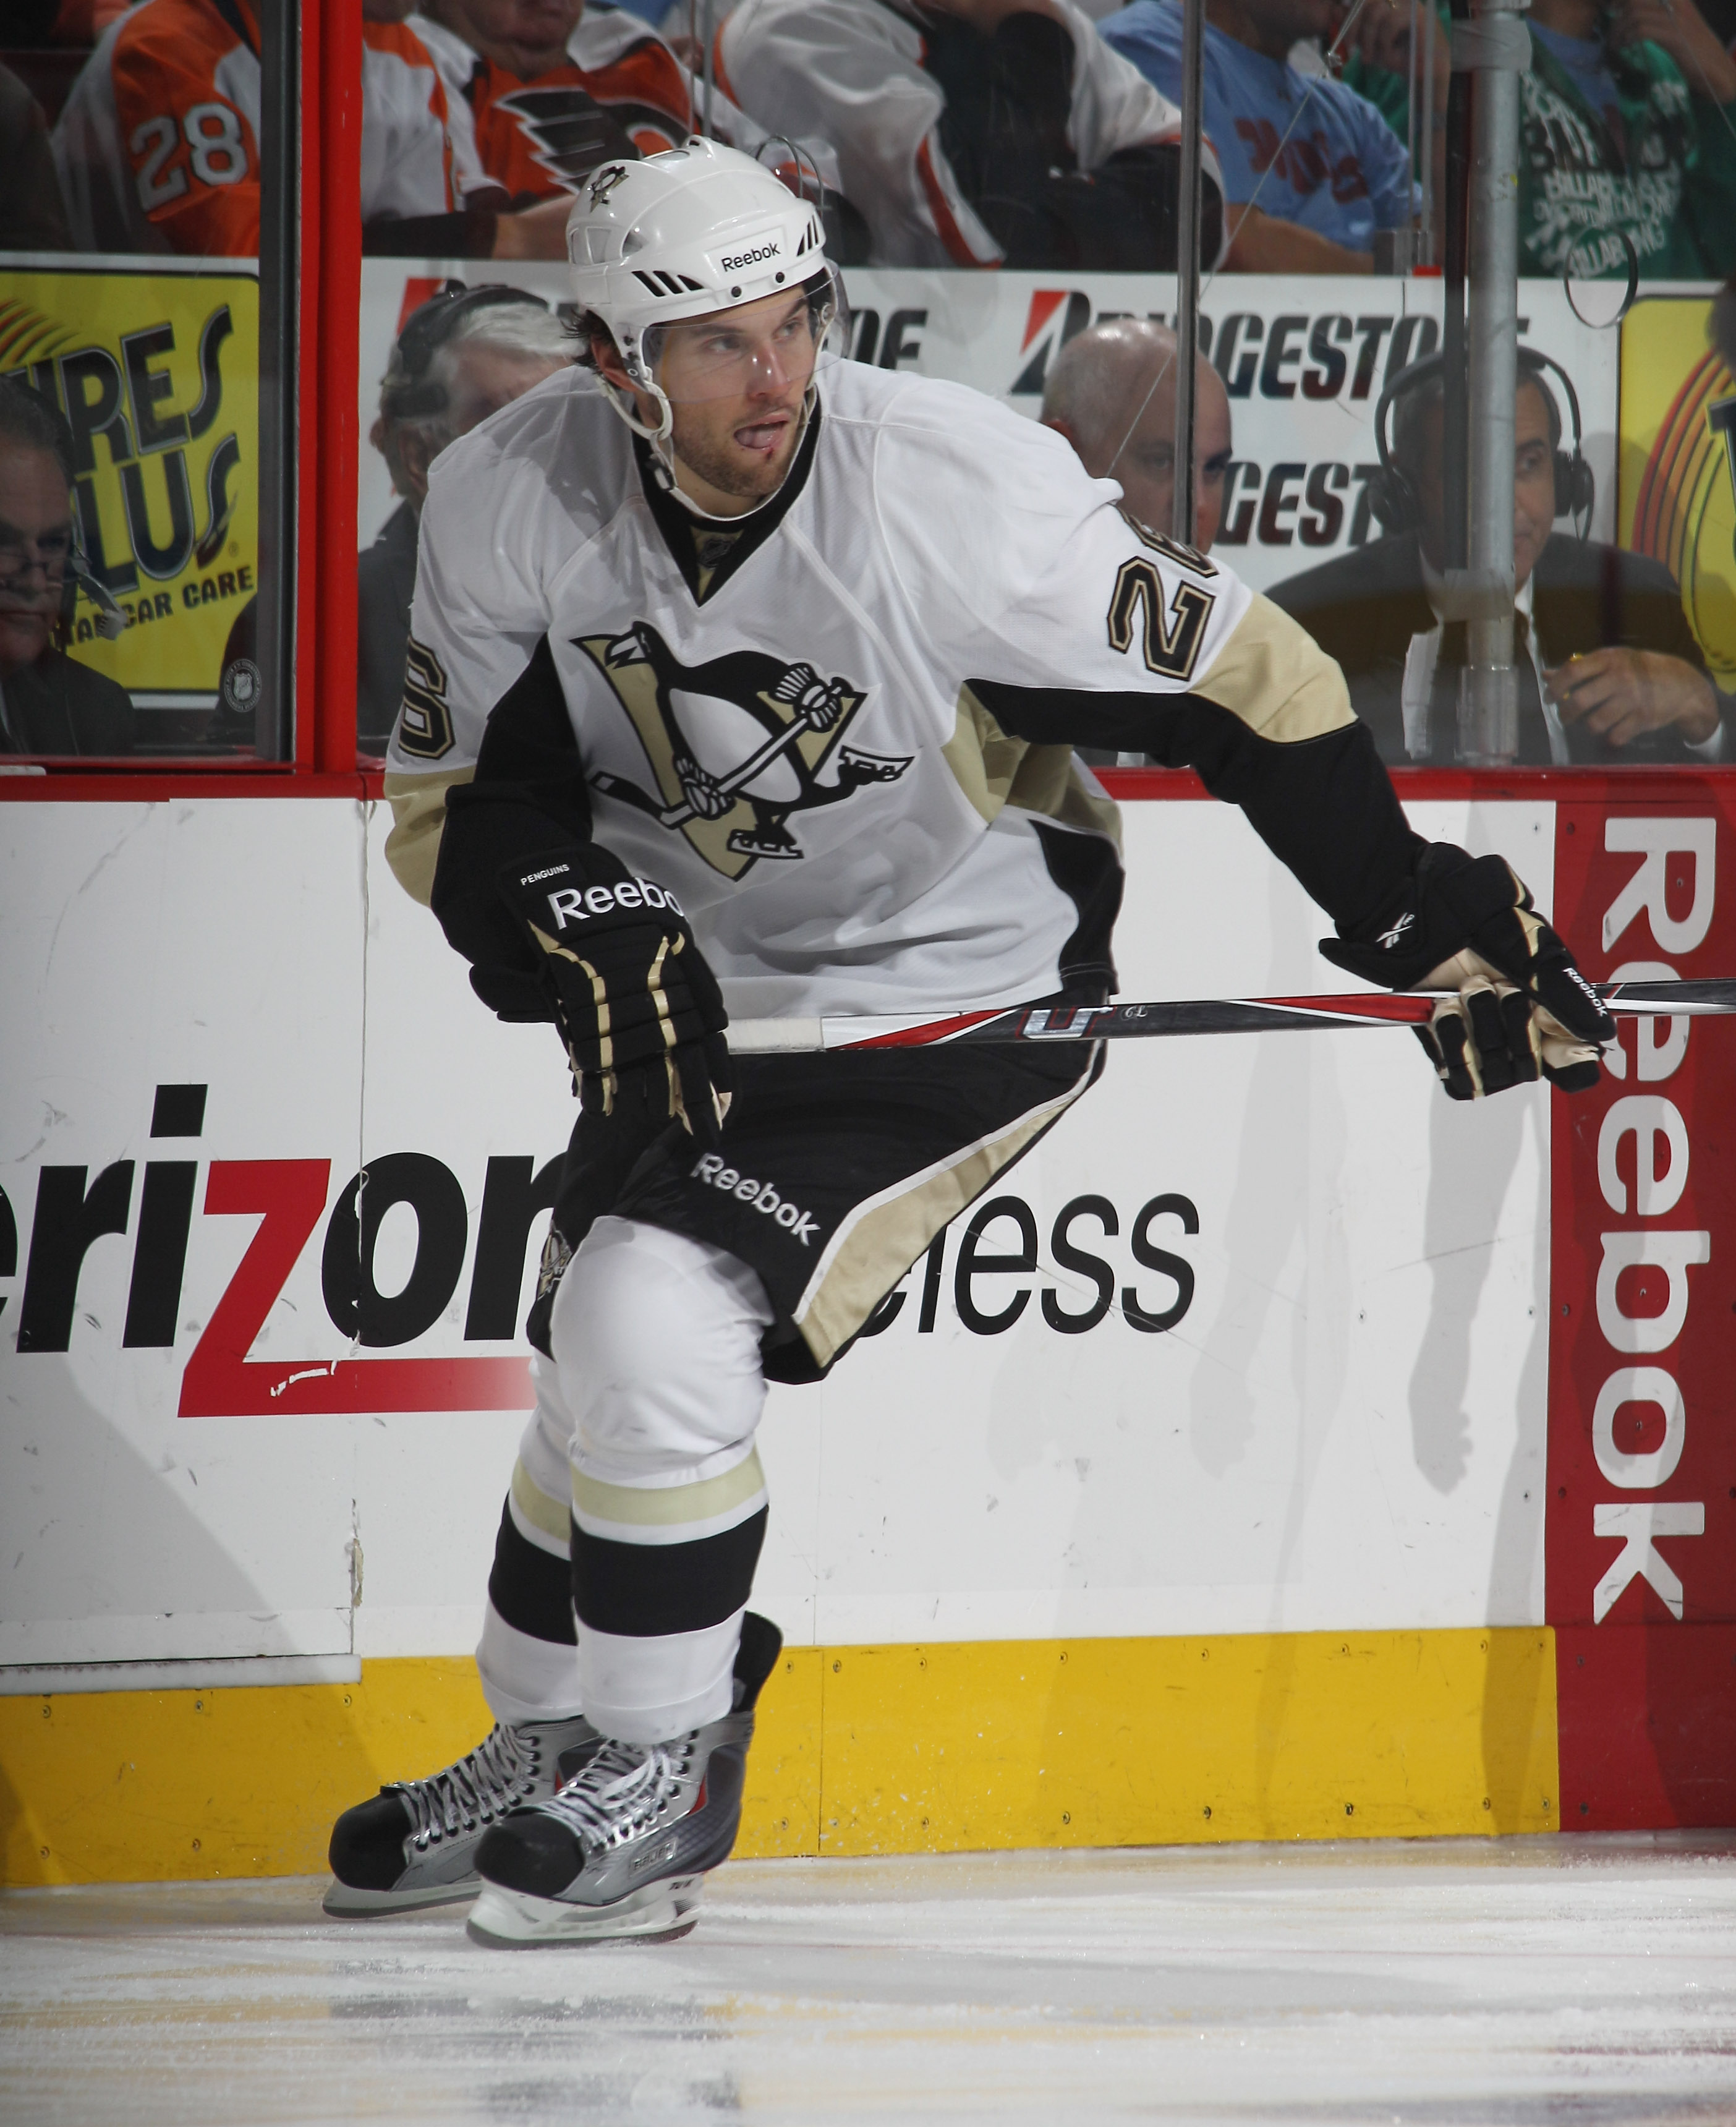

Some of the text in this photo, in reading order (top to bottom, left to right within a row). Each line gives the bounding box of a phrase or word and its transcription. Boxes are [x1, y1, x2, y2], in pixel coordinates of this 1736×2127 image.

[130, 102, 248, 213] 28
[721, 242, 781, 272] Reebok
[1010, 289, 1530, 402] BGESTO
[72, 432, 240, 597] LUS
[182, 566, 254, 609] CARE
[398, 631, 456, 761] 6
[521, 864, 570, 886] PENGUINS
[547, 877, 684, 931] Reebo
[1562, 967, 1608, 1017] Reebok
[0, 1083, 566, 1418] rizon
[691, 1153, 820, 1247] Reebok
[1591, 817, 1717, 1624] Reebok
[858, 1192, 1199, 1338] less
